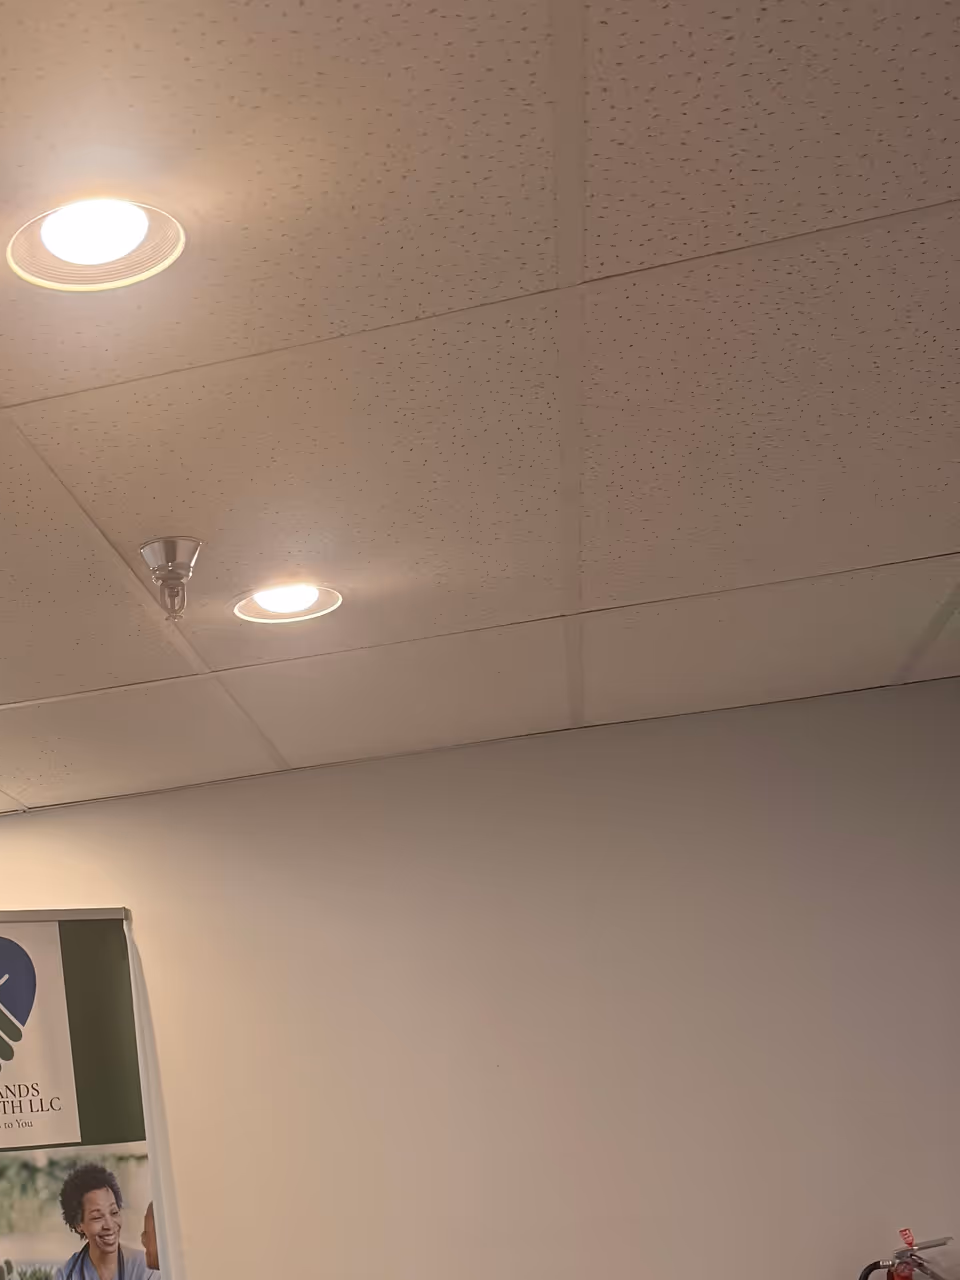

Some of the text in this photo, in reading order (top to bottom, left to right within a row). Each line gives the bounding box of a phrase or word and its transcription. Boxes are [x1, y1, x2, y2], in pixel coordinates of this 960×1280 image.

[29, 1097, 62, 1113] LLC
[4, 1121, 13, 1129] to
[16, 1119, 33, 1129] You
